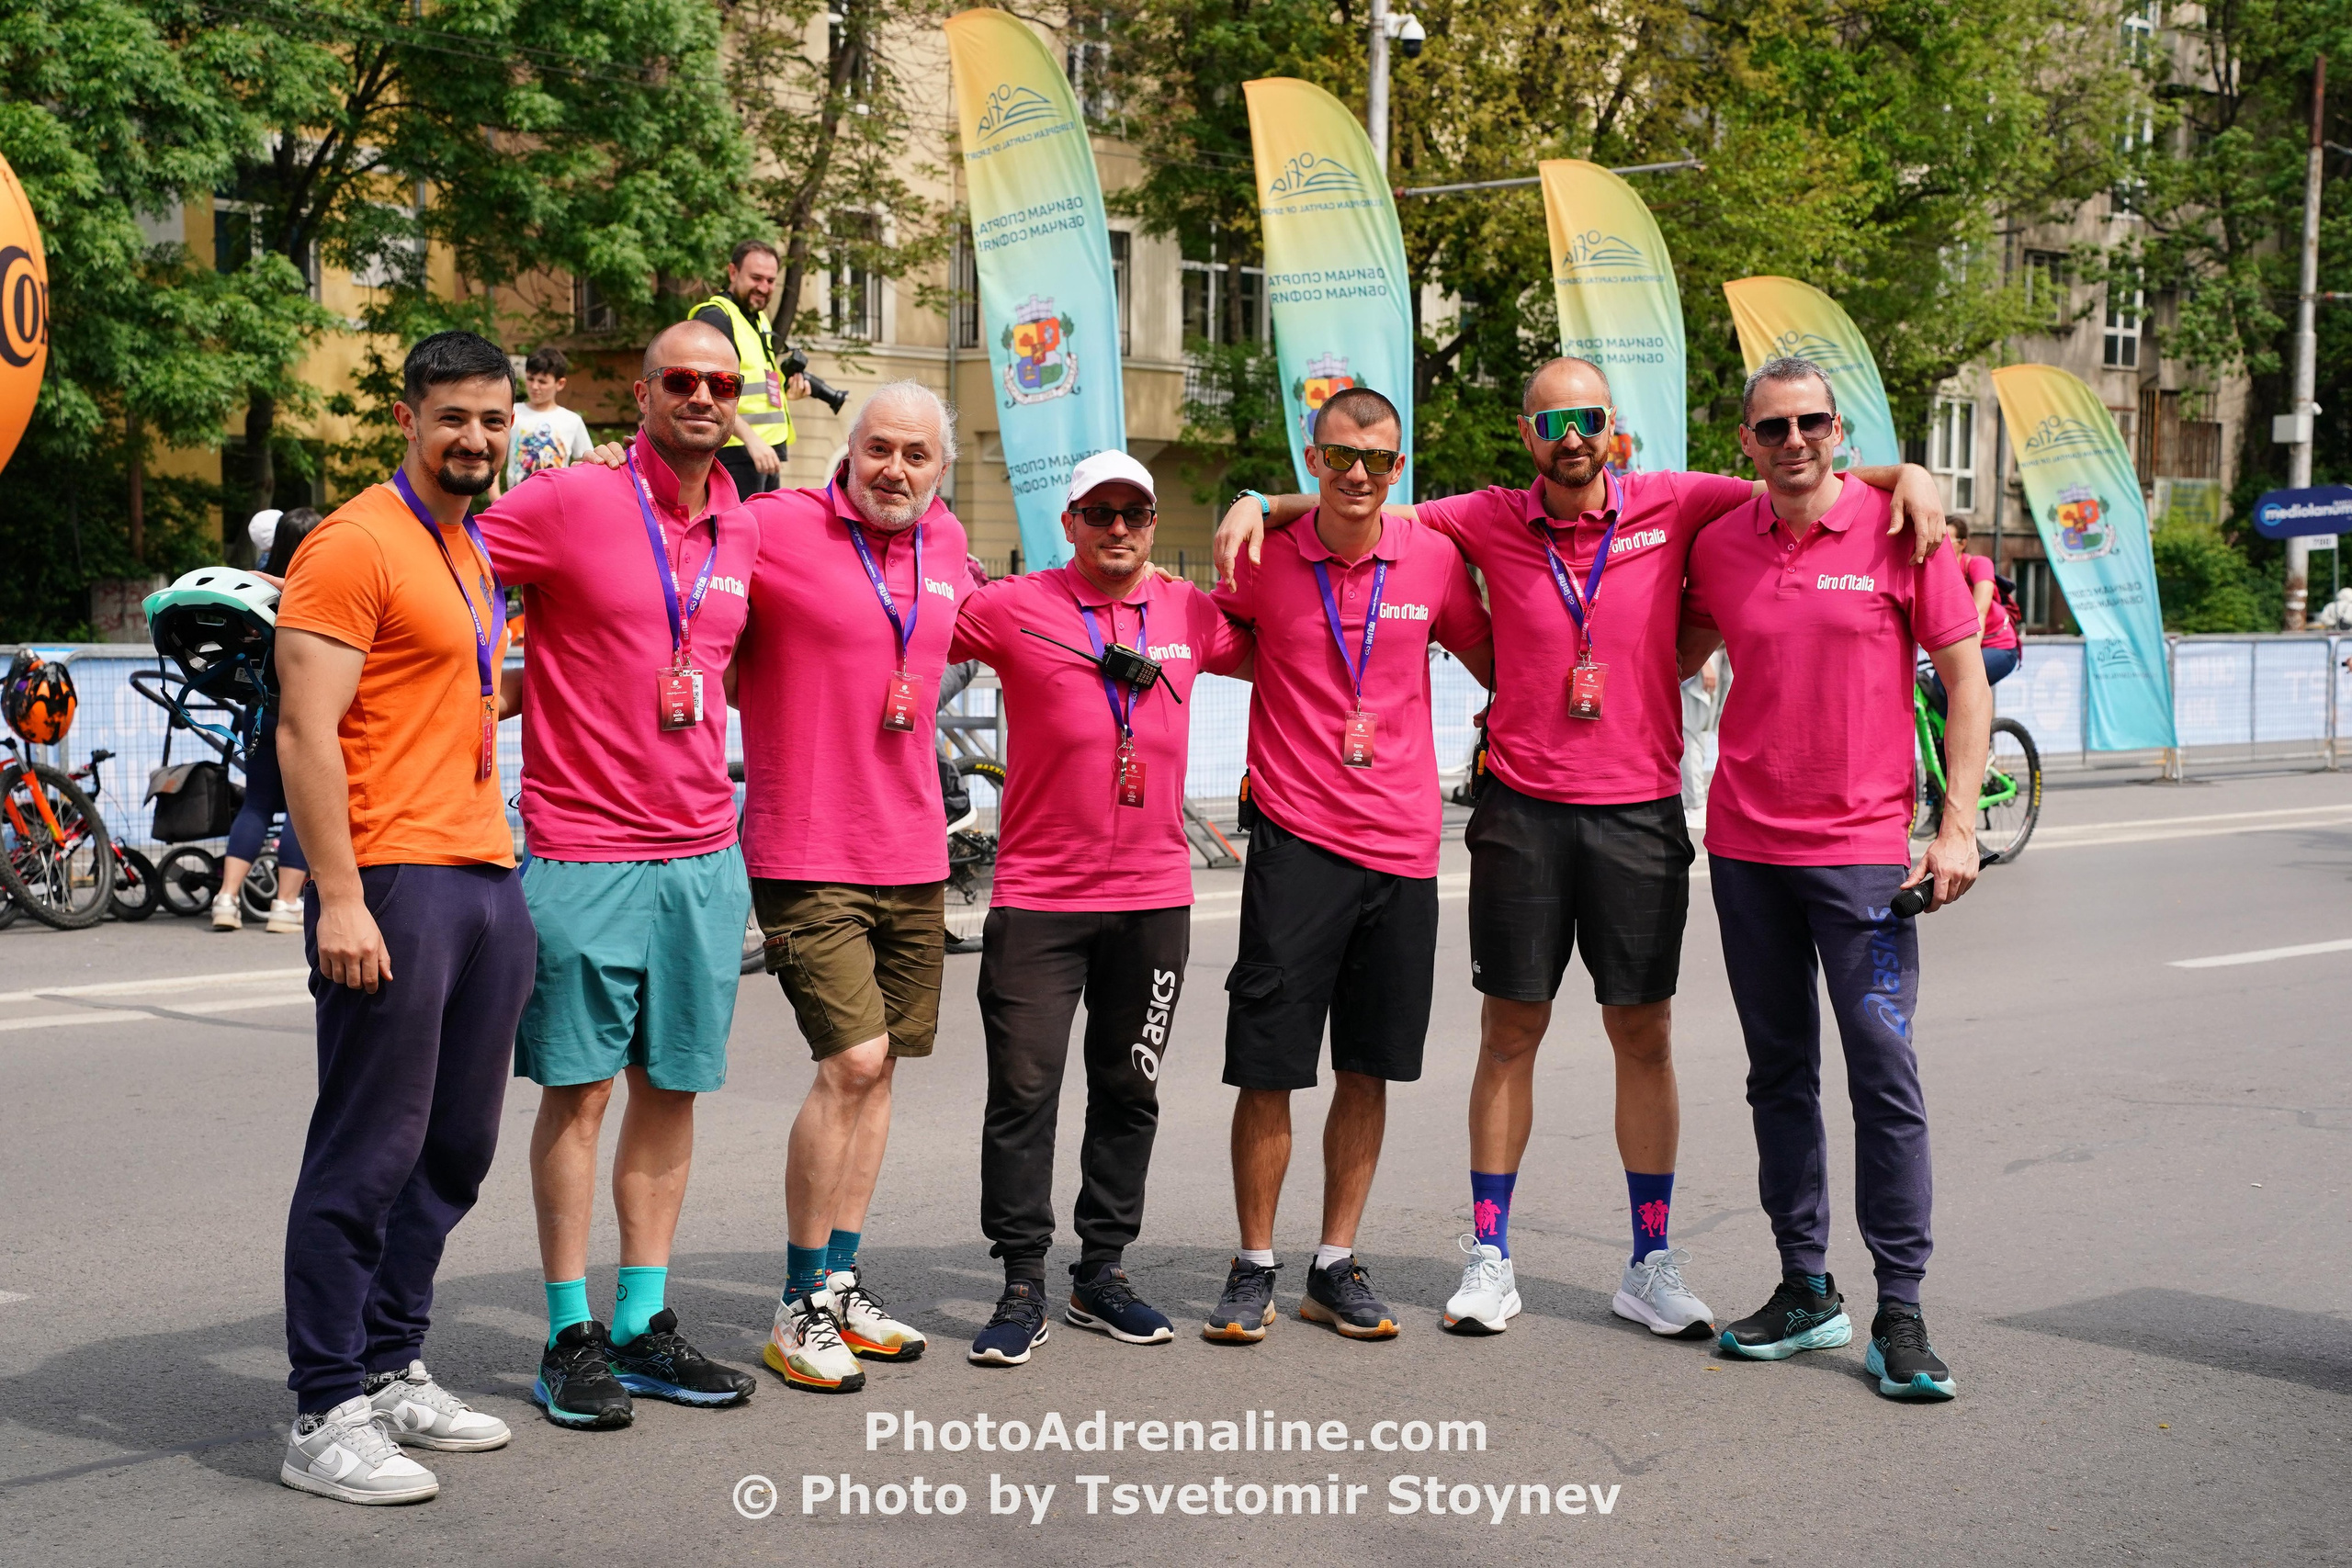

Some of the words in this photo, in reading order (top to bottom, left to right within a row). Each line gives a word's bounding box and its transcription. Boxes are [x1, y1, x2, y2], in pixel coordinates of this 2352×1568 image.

[1633, 528, 1666, 548] d'Italia
[709, 574, 724, 591] iro
[924, 577, 942, 594] Giro
[1816, 573, 1838, 590] Giro
[1838, 573, 1874, 592] d'Italia
[1379, 603, 1400, 619] Giro
[1401, 604, 1429, 620] d'Italia
[1148, 646, 1169, 660] Giro
[1168, 643, 1191, 659] d'Italia
[1142, 968, 1176, 1045] asics
